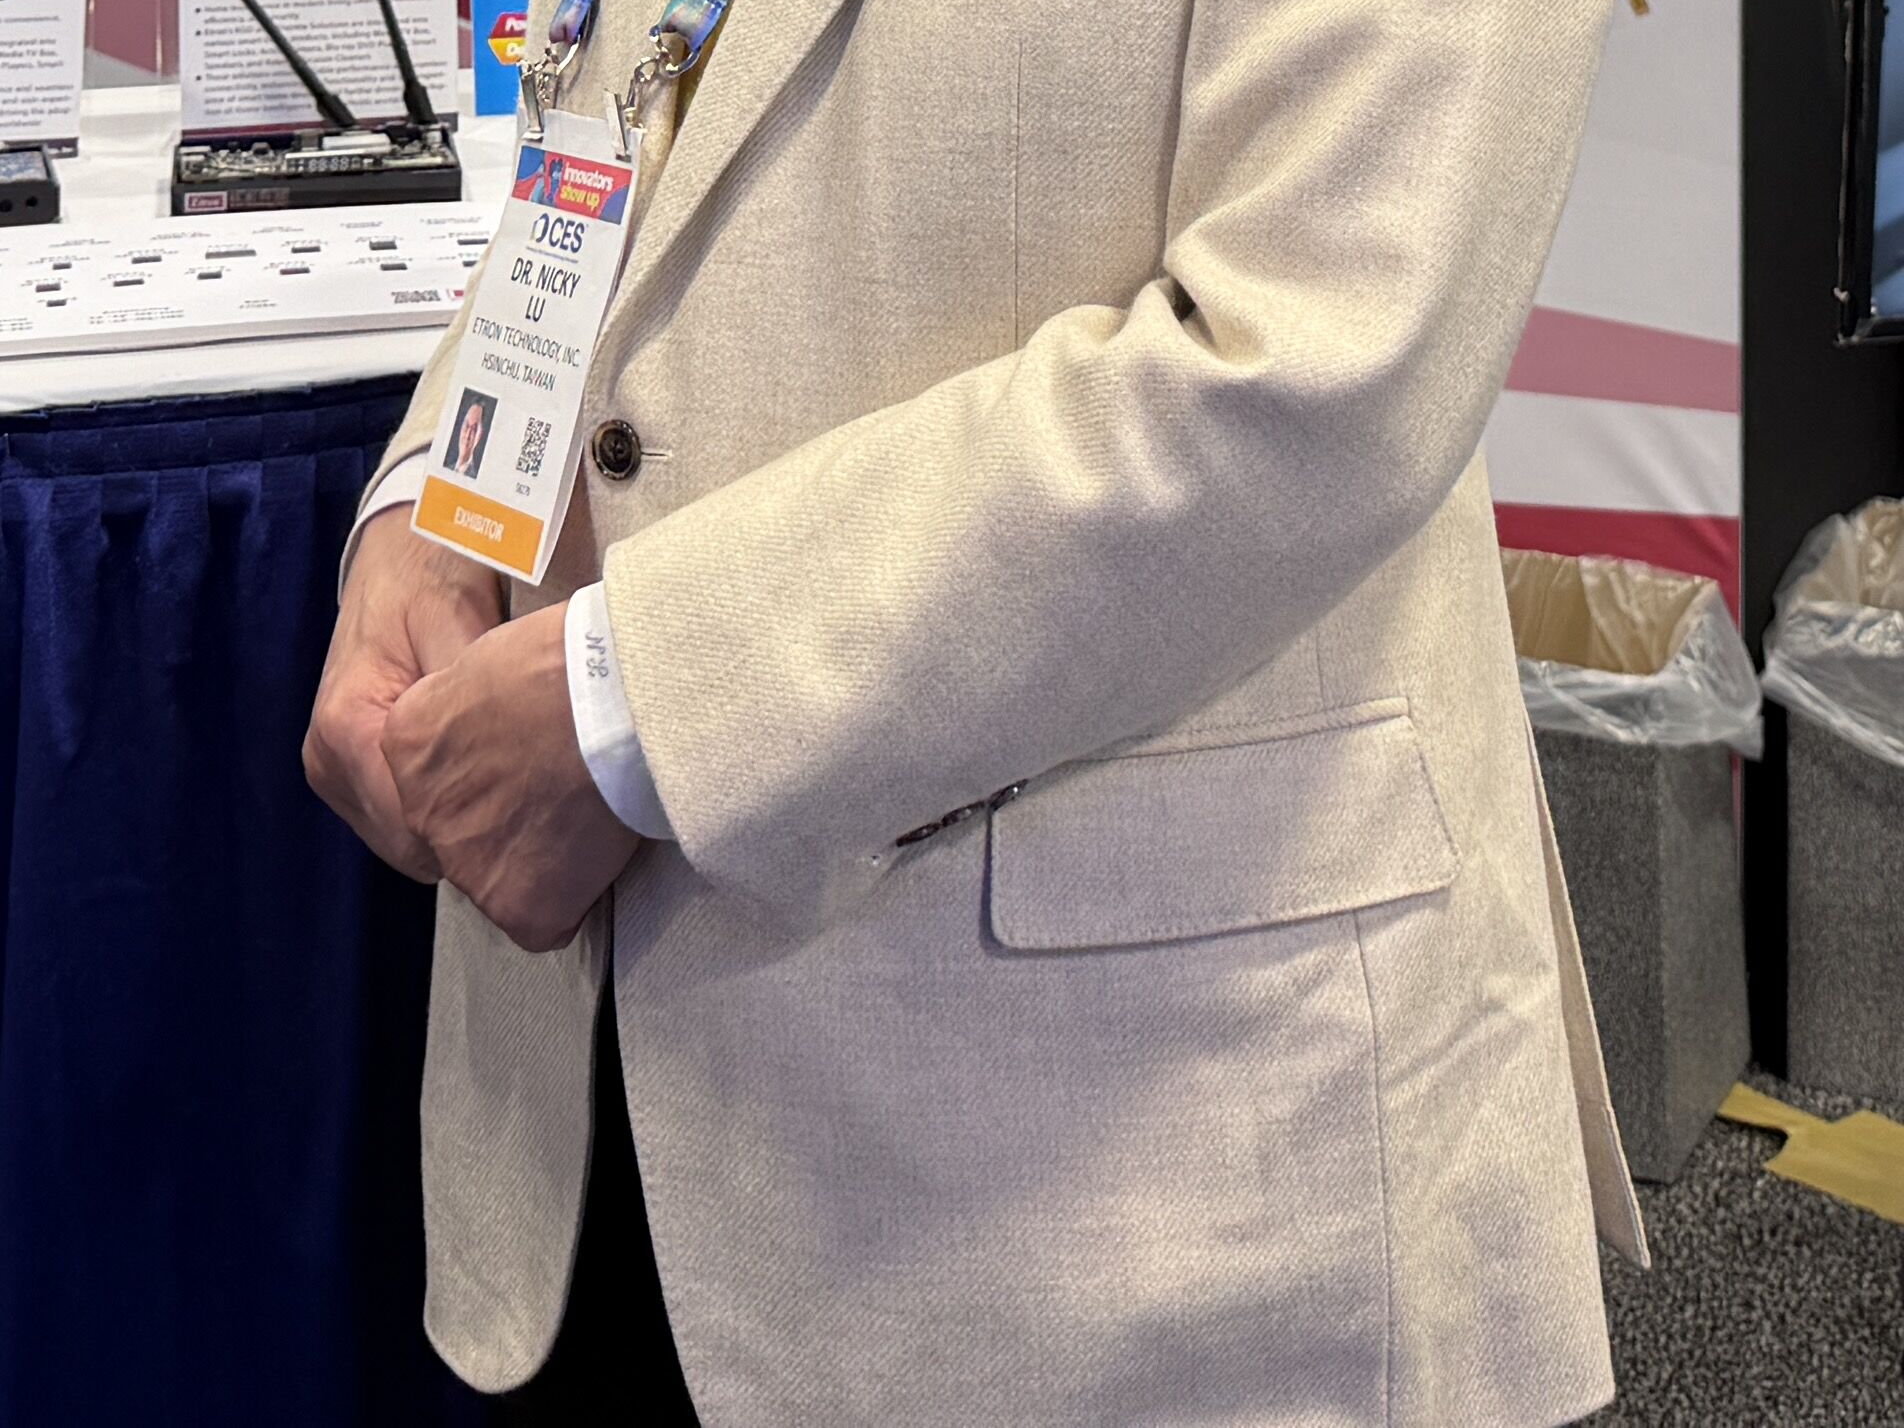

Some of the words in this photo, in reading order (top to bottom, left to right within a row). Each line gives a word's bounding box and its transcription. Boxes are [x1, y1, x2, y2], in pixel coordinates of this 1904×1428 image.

[548, 215, 587, 256] CES
[510, 256, 534, 288] DR.
[534, 266, 583, 300] NICKY
[526, 297, 548, 323] LU
[522, 364, 557, 393] TAIWAN
[453, 503, 505, 544] EXHIBITOR
